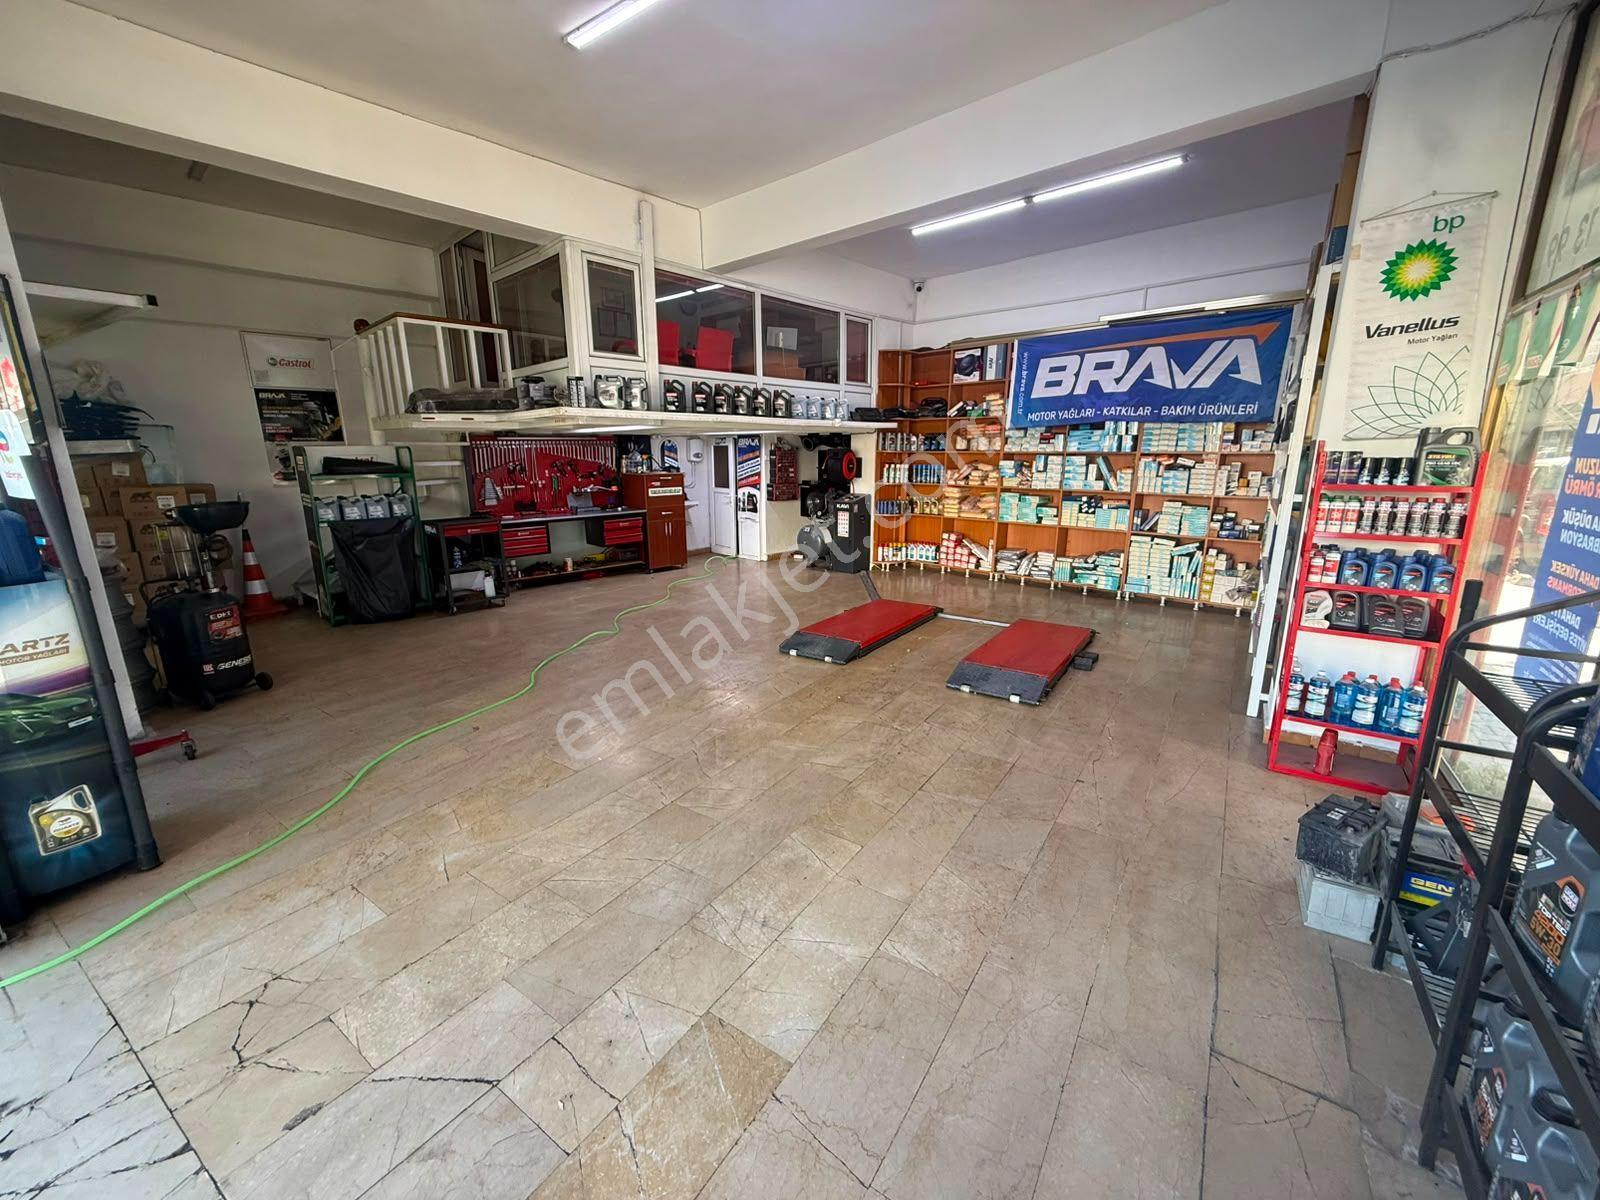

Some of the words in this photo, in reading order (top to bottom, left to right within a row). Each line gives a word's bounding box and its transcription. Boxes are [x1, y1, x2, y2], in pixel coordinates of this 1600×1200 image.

[1433, 214, 1465, 234] bp
[1365, 316, 1461, 339] Vanellus
[1407, 336, 1429, 345] Motor
[278, 357, 312, 369] Castrol
[1031, 338, 1262, 399] BRAVA
[1027, 410, 1056, 421] MOTOR
[1058, 407, 1095, 420] YAĞLARI
[1103, 406, 1151, 417] KATKILAR
[1160, 404, 1196, 416] BAKIM
[1198, 401, 1258, 416] ÜRÜNLERİ
